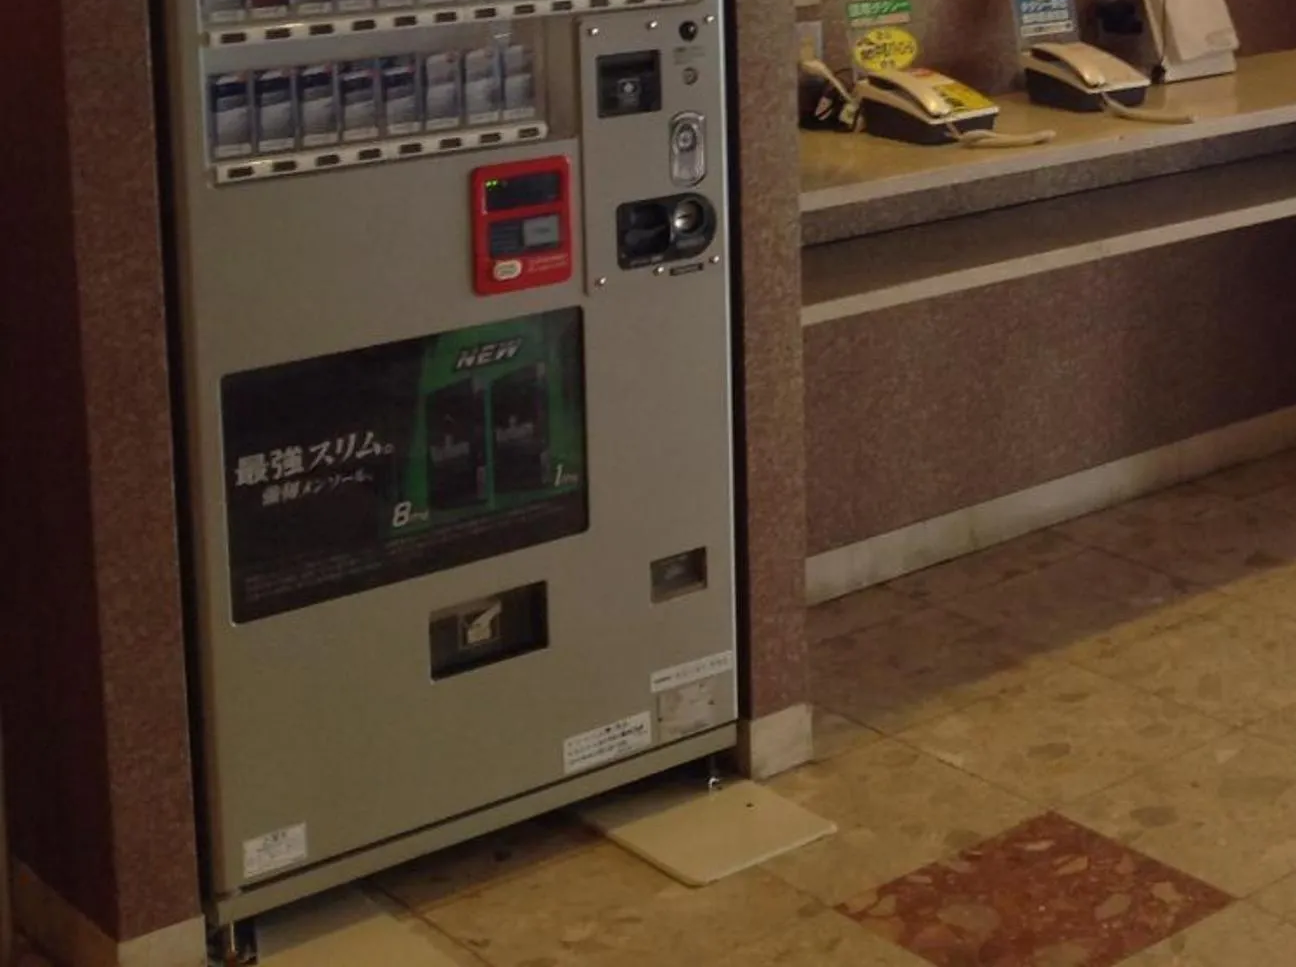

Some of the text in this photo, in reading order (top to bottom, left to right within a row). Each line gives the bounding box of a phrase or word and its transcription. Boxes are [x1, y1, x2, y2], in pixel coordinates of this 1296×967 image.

[456, 339, 522, 368] NEW
[235, 432, 394, 486] 最強スリム。
